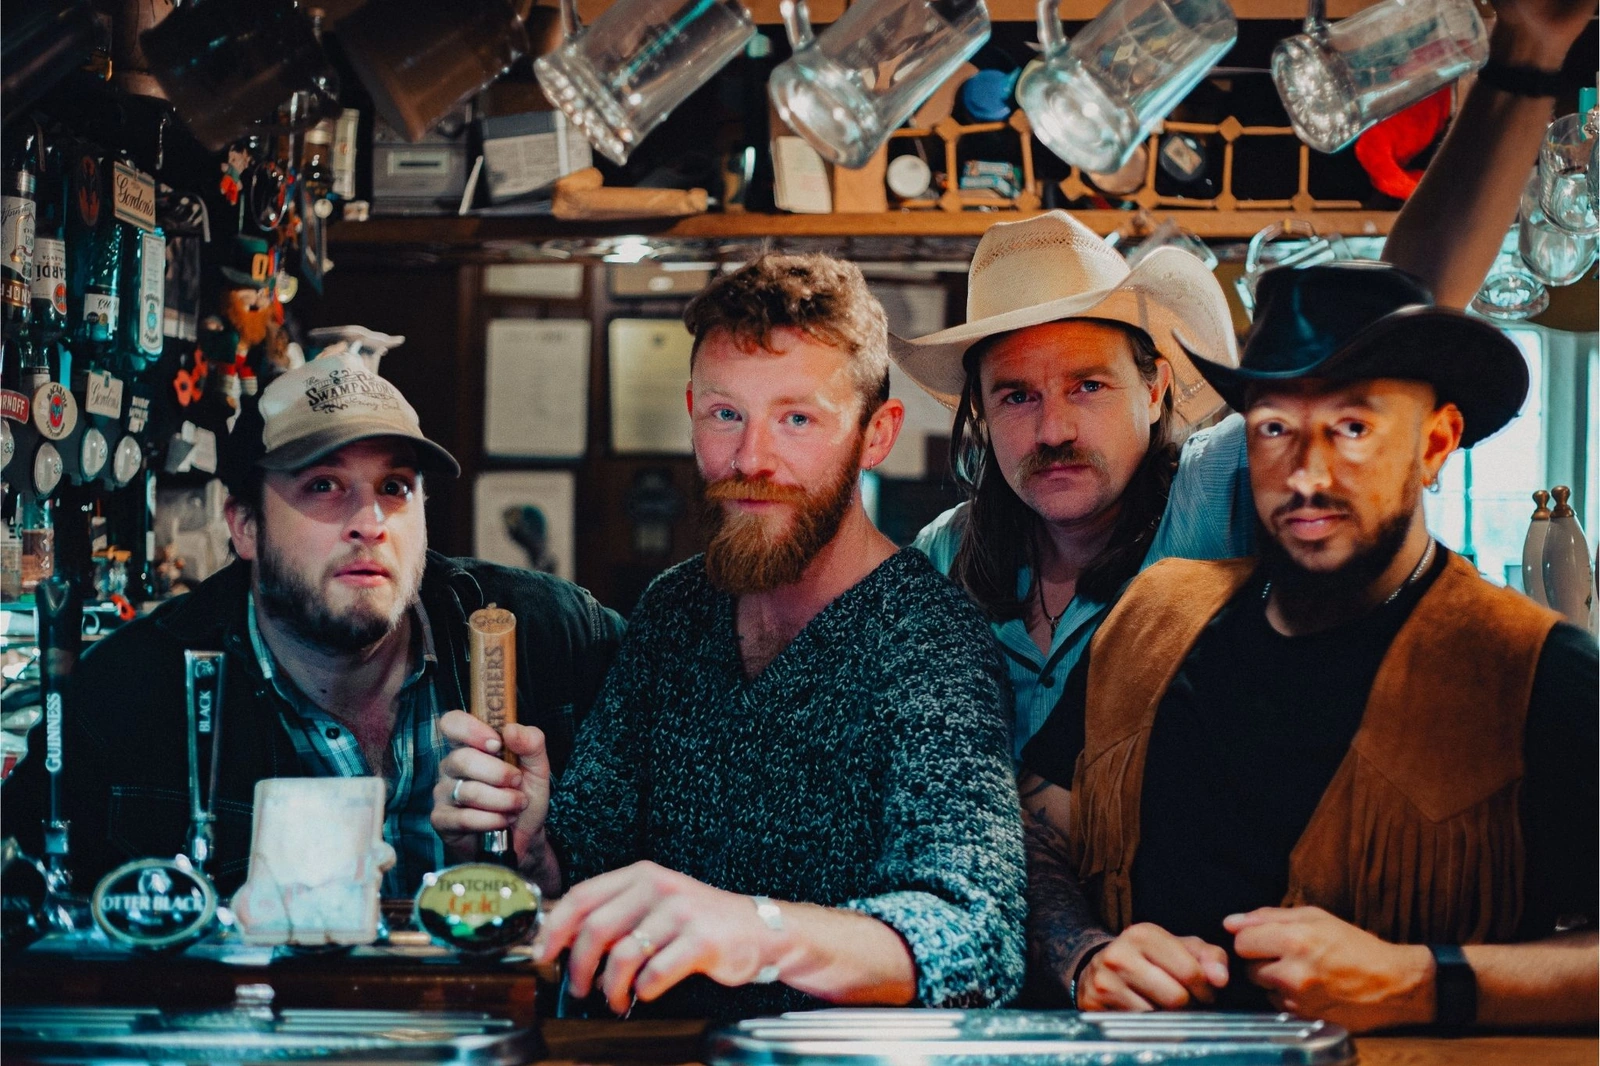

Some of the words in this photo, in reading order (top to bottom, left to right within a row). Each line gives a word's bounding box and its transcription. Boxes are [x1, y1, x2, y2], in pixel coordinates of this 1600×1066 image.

[116, 174, 154, 217] Gordon's
[36, 264, 66, 282] ARDÍ
[305, 382, 359, 406] SWAMP
[484, 646, 505, 732] ATCHERS
[45, 692, 63, 773] GUINNESS
[198, 690, 211, 733] BLACK
[100, 894, 151, 911] OTTER
[152, 894, 204, 911] BLACK
